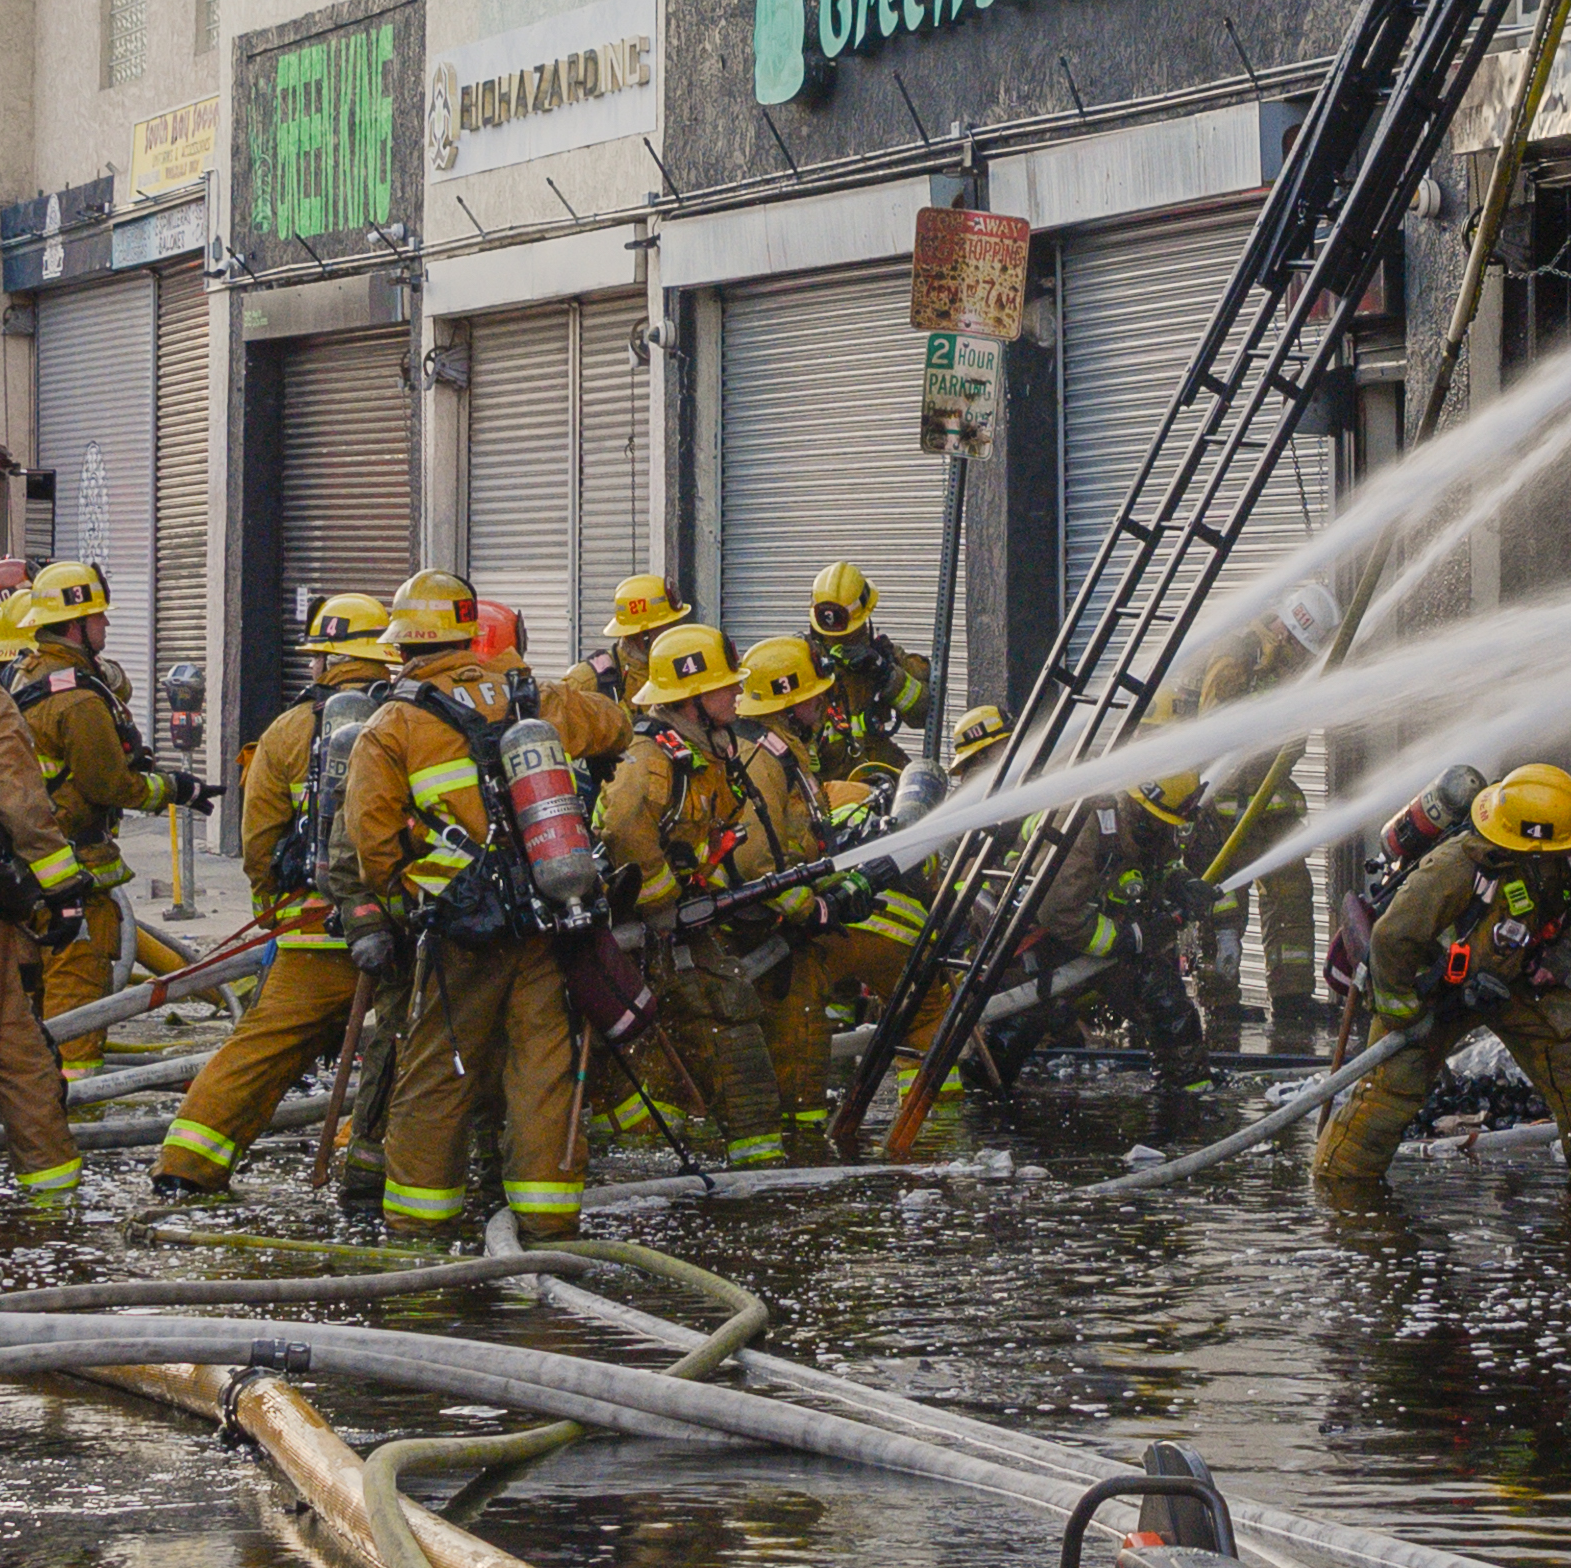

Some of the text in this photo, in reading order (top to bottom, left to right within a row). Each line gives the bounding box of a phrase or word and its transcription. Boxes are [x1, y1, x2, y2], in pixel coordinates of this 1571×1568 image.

[931, 338, 995, 371] 2 HOUR
[929, 373, 993, 401] PARKING
[73, 586, 84, 603] 3
[629, 598, 648, 616] 27
[326, 617, 340, 637] 4
[824, 611, 835, 625] 3
[681, 656, 698, 674] 4
[778, 676, 792, 694] 3
[1526, 824, 1543, 839] 4
